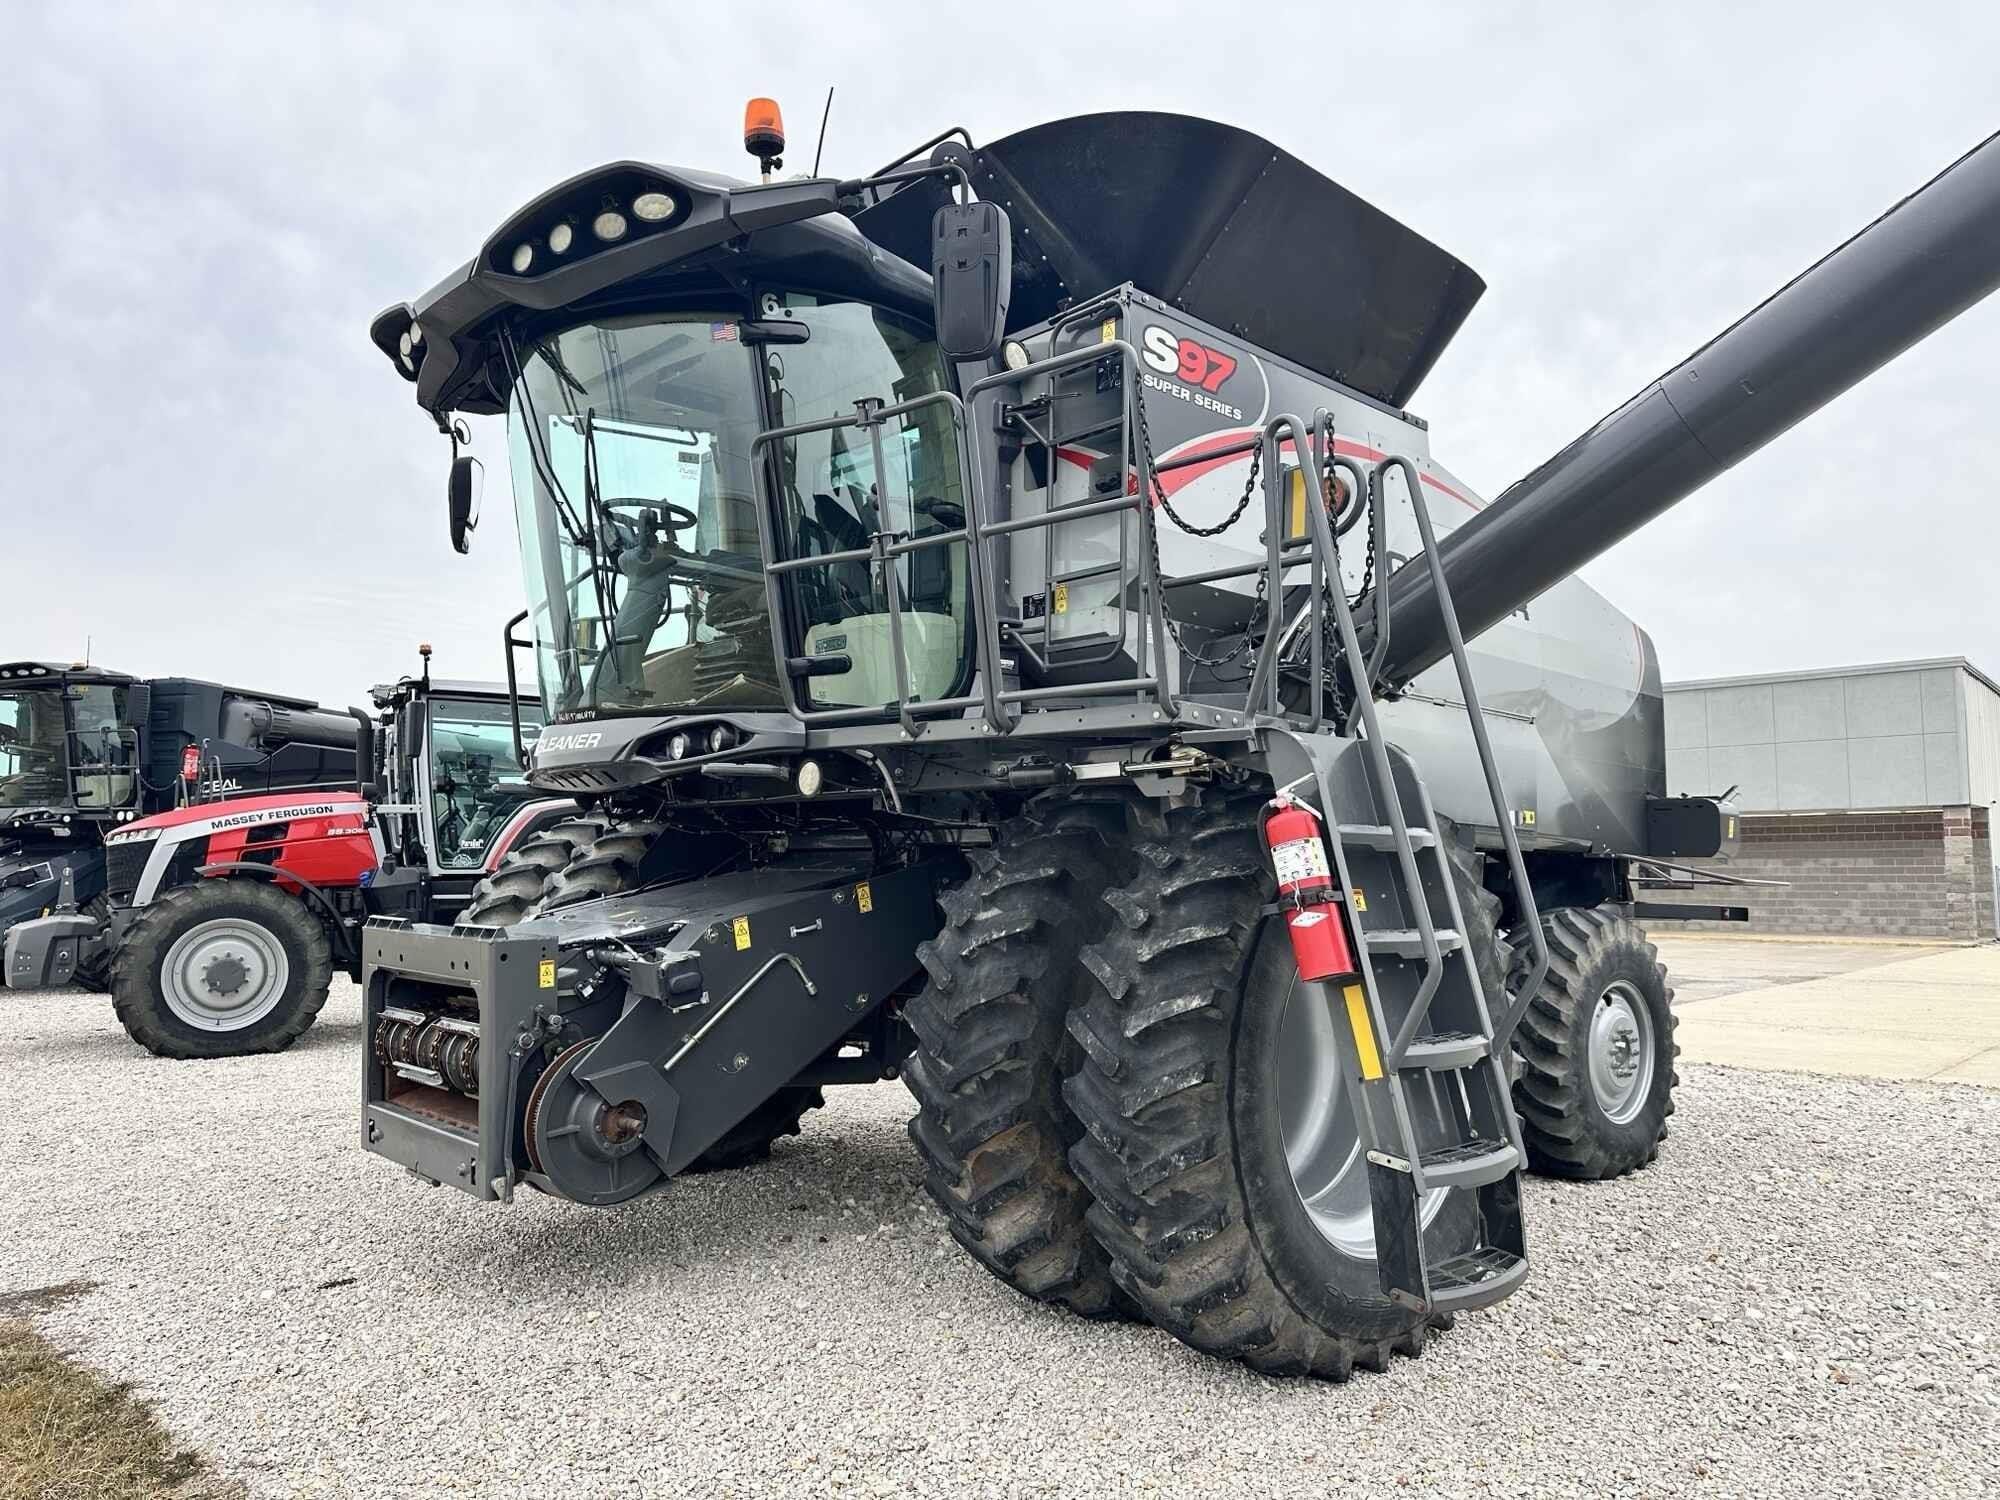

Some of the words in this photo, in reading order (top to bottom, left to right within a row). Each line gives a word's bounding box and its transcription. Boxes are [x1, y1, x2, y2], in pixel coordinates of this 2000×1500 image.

[1141, 324, 1237, 395] S97
[1143, 374, 1190, 401] SUPER
[1194, 393, 1242, 420] SERIES
[200, 778, 243, 793] EAL
[211, 813, 264, 830] MASSEY
[268, 805, 334, 820] FERGUSON
